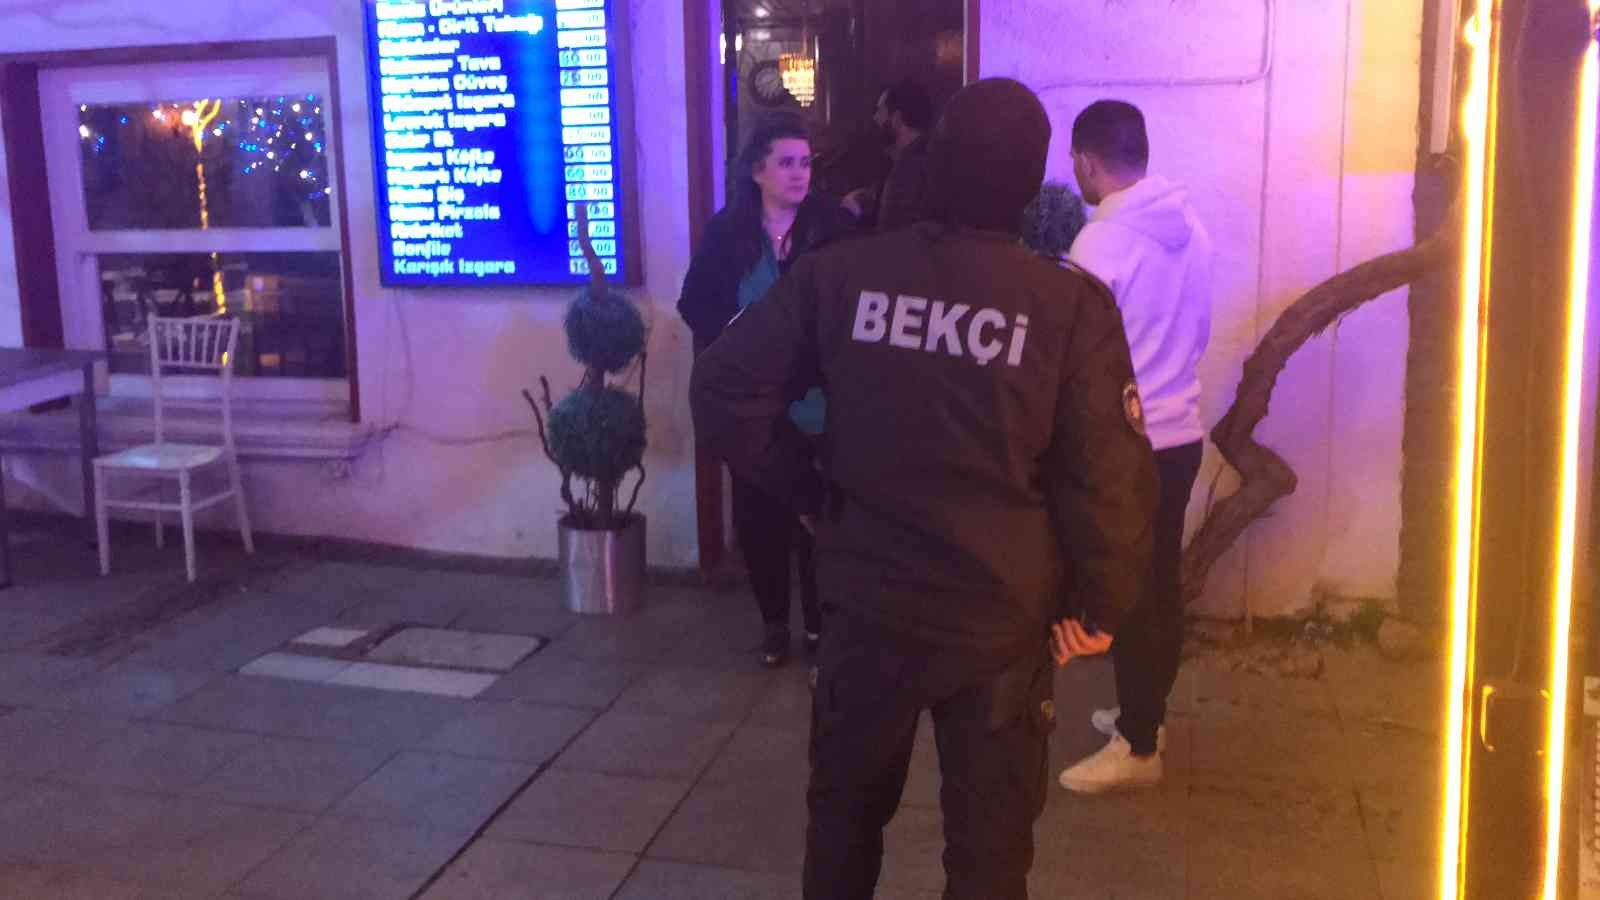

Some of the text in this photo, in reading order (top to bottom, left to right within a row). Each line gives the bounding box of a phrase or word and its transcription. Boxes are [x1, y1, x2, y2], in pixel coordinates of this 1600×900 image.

[457, 55, 500, 70] Tava
[393, 241, 450, 258] Bonfile
[394, 259, 515, 276] Karışık Izgara
